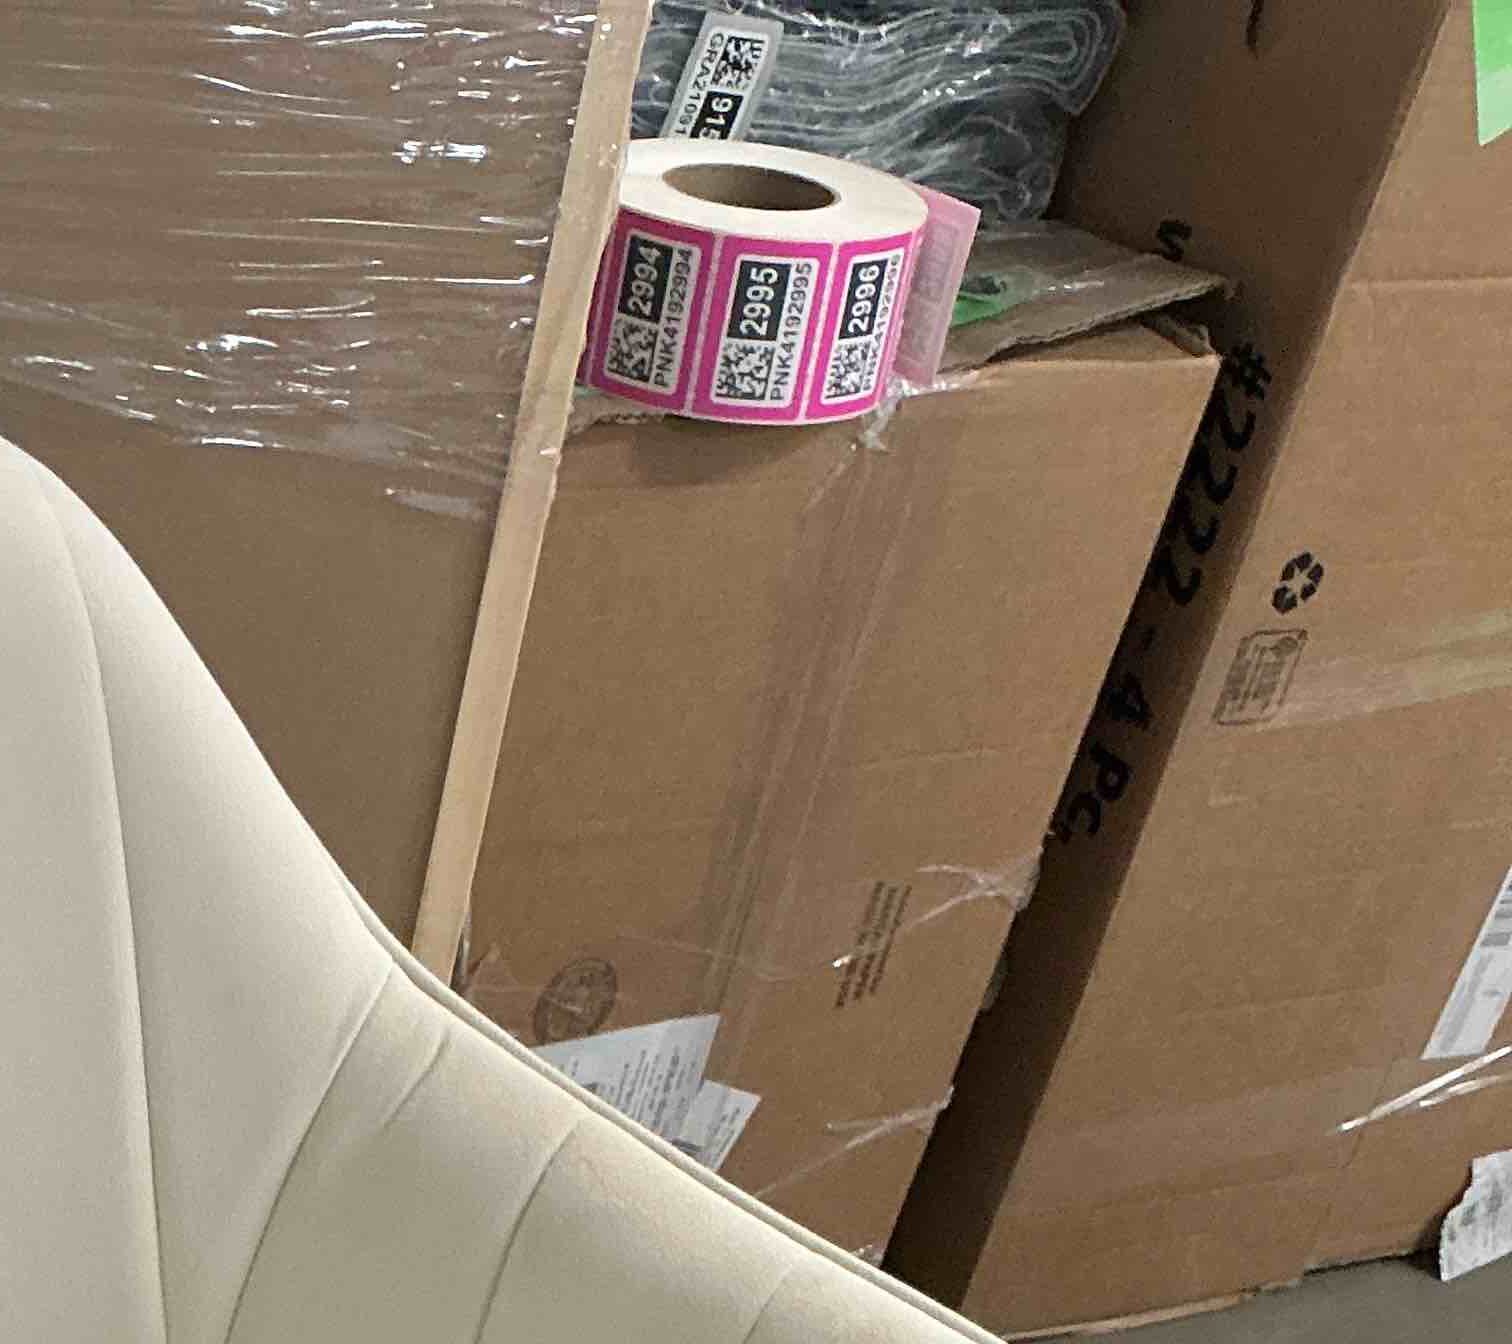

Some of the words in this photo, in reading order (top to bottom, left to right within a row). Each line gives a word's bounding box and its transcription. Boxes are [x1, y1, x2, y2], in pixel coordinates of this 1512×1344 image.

[628, 245, 662, 317] 2994
[653, 248, 694, 386] PNK4192994
[742, 266, 779, 337] 2995
[847, 264, 881, 334] 2996
[769, 262, 812, 401] PNK4192995
